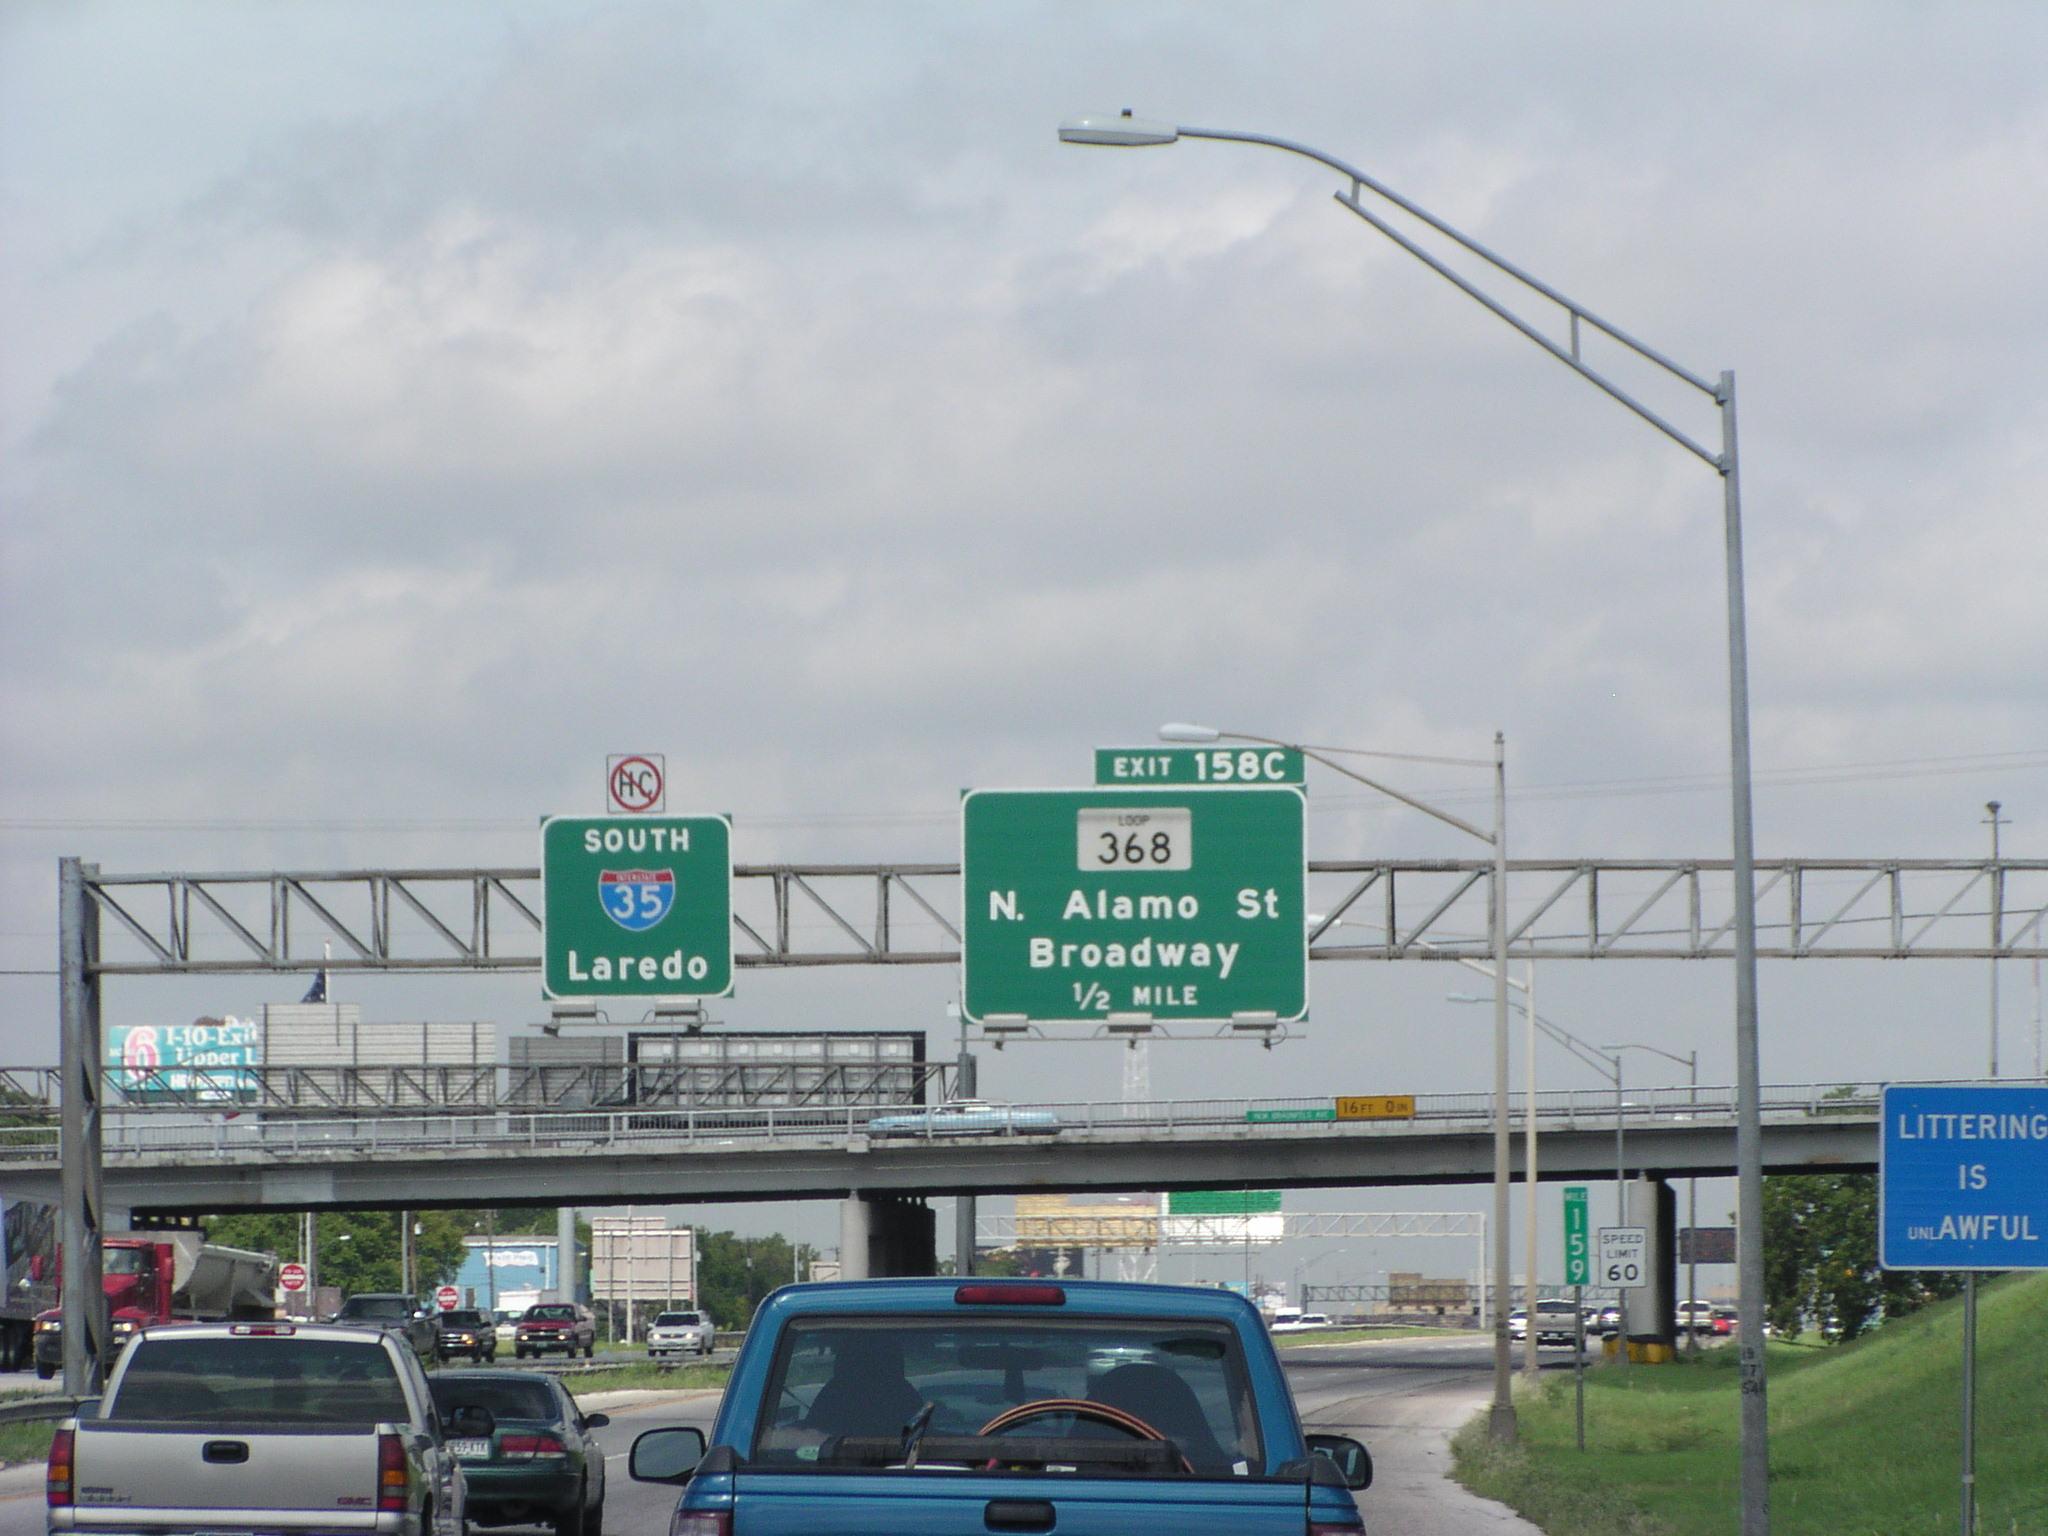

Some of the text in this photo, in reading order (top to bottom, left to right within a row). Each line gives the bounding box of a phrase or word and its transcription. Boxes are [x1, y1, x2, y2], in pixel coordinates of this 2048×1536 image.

[1113, 752, 1285, 780] EXIT 158C
[619, 770, 652, 798] HC
[1118, 815, 1150, 827] LOOP
[584, 828, 689, 852] SOUTH
[1098, 832, 1171, 864] 368
[613, 885, 662, 918] 35
[989, 888, 1280, 921] N. Alamo St
[568, 950, 708, 981] Laredo
[1029, 937, 1240, 979] Broadway
[1072, 982, 1198, 1010] 1/2 MILE
[1899, 1114, 2048, 1140] LITTERING
[1959, 1164, 1987, 1190] IS
[1602, 1234, 1643, 1244] SPEED
[1908, 1215, 2039, 1240] UNLAWFUL
[1606, 1249, 1638, 1258] LIMIT
[1608, 1264, 1638, 1281] 60
